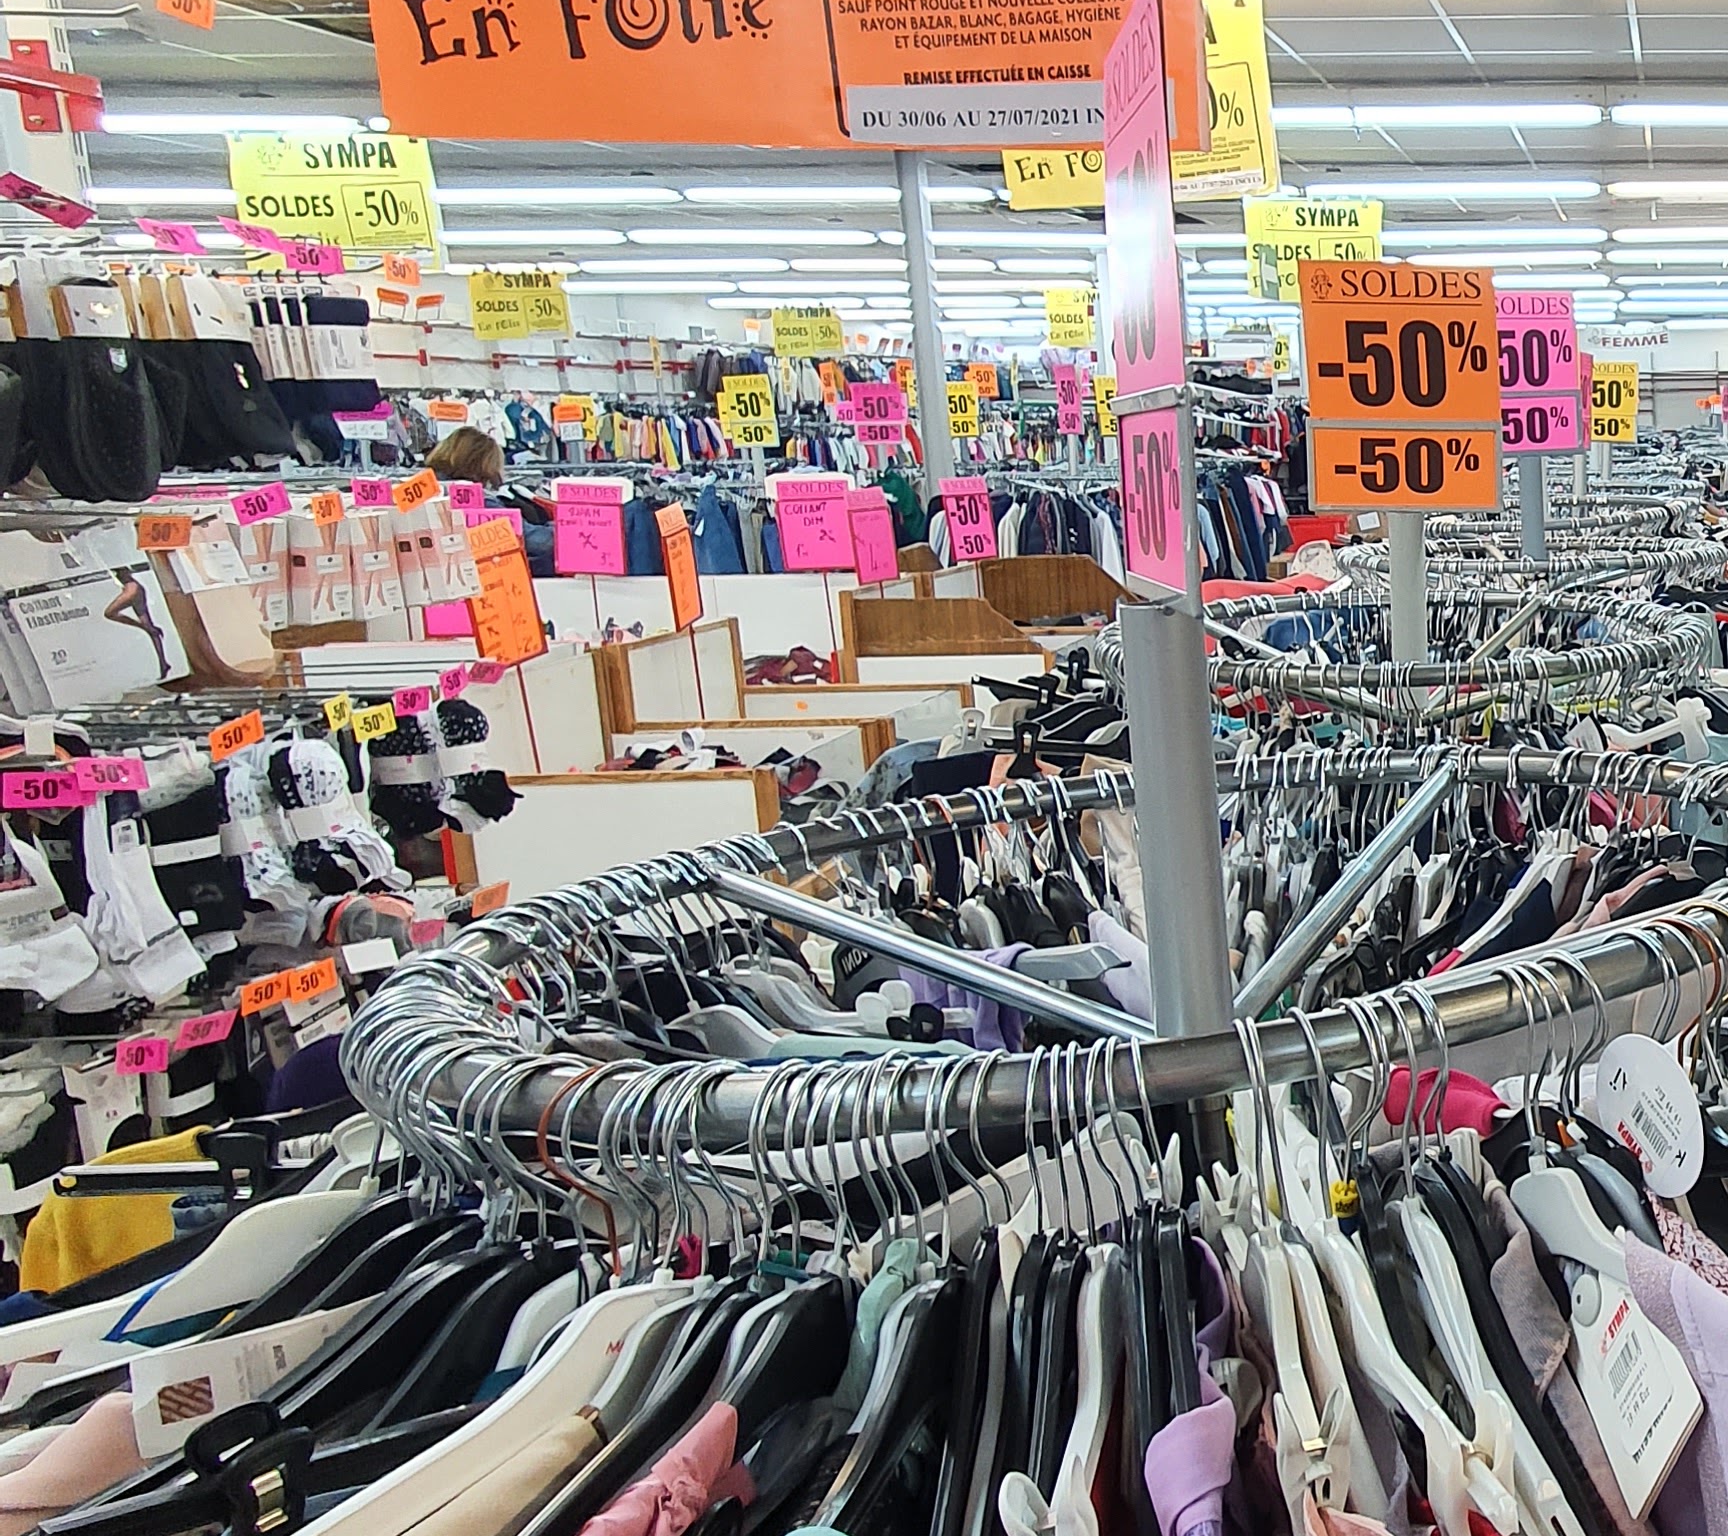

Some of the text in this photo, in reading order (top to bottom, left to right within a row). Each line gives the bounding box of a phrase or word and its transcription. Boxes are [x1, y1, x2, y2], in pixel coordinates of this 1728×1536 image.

[838, 0, 872, 14] SAUF
[860, 6, 1121, 32] RAYON BAZAR, BLANC, BAGAGE, HYGIÈNE
[894, 27, 1092, 50] ET ÉQUIPEMENT DE LA MAISON
[904, 64, 1091, 85] REMISE EFFECTUÉE EN CAISSE
[862, 110, 892, 128] DU
[898, 109, 947, 127] 30/06
[952, 109, 982, 127] AU
[987, 107, 1079, 127] 27/07/2021
[303, 140, 398, 169] SYMPA
[1014, 156, 1053, 183] En
[246, 195, 334, 218] SOLDES
[354, 189, 419, 228] -50%
[1295, 207, 1360, 227] SYMPA
[1252, 243, 1311, 261] SLDES
[503, 274, 551, 288] SYMPA
[1341, 269, 1482, 299] SOLDES
[476, 300, 519, 312] SOLDES
[1049, 313, 1084, 324] SOLDES
[1601, 332, 1669, 348] FEMME
[1318, 319, 1487, 408] -50%
[1497, 329, 1573, 388] 50%
[730, 391, 771, 418] -50%
[1592, 380, 1635, 409] 50%
[1501, 406, 1569, 445] 50%
[1593, 418, 1630, 436] 50%
[1335, 437, 1480, 495] -50%
[570, 485, 619, 498] SOLDES
[791, 482, 844, 495] SOLDES
[1129, 428, 1180, 561] -50%
[951, 496, 988, 526] -50%
[1616, 1120, 1643, 1158] SYMPA
[1608, 1299, 1630, 1340] SYMPA
